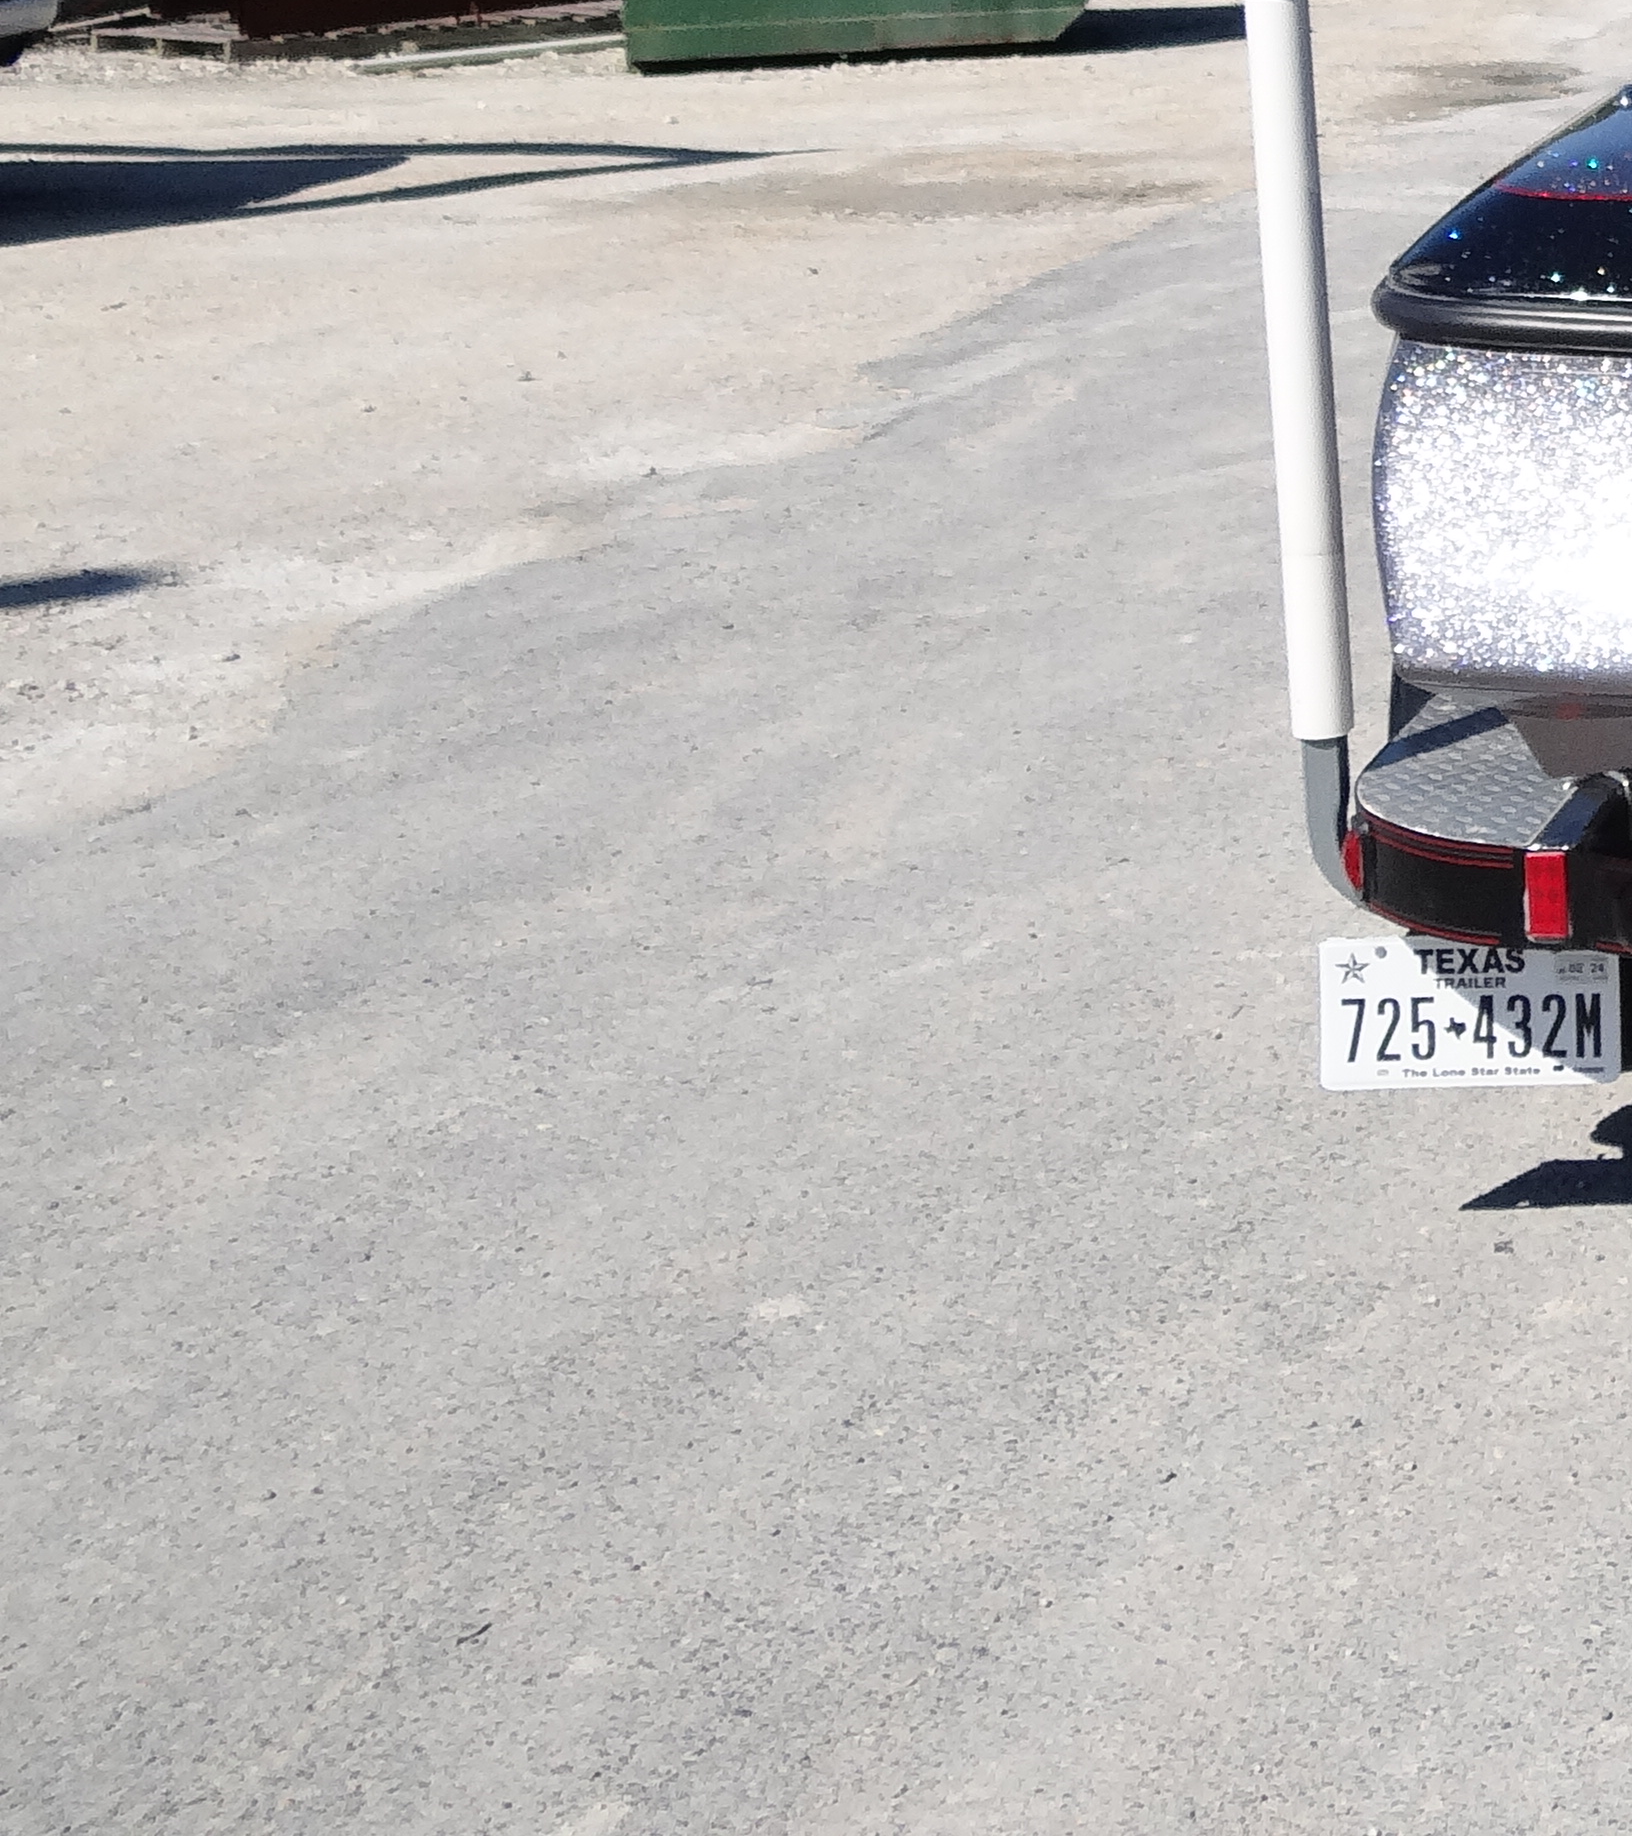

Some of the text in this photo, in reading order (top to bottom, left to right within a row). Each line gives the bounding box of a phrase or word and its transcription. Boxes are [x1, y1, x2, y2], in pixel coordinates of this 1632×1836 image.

[1414, 948, 1526, 975] TEXAS
[1433, 976, 1507, 989] TRAILER
[1341, 992, 1603, 1063] 725 432M
[1401, 1067, 1428, 1078] The
[1432, 1067, 1466, 1078] Lone
[1470, 1066, 1500, 1077] Star
[1504, 1065, 1541, 1076] State
